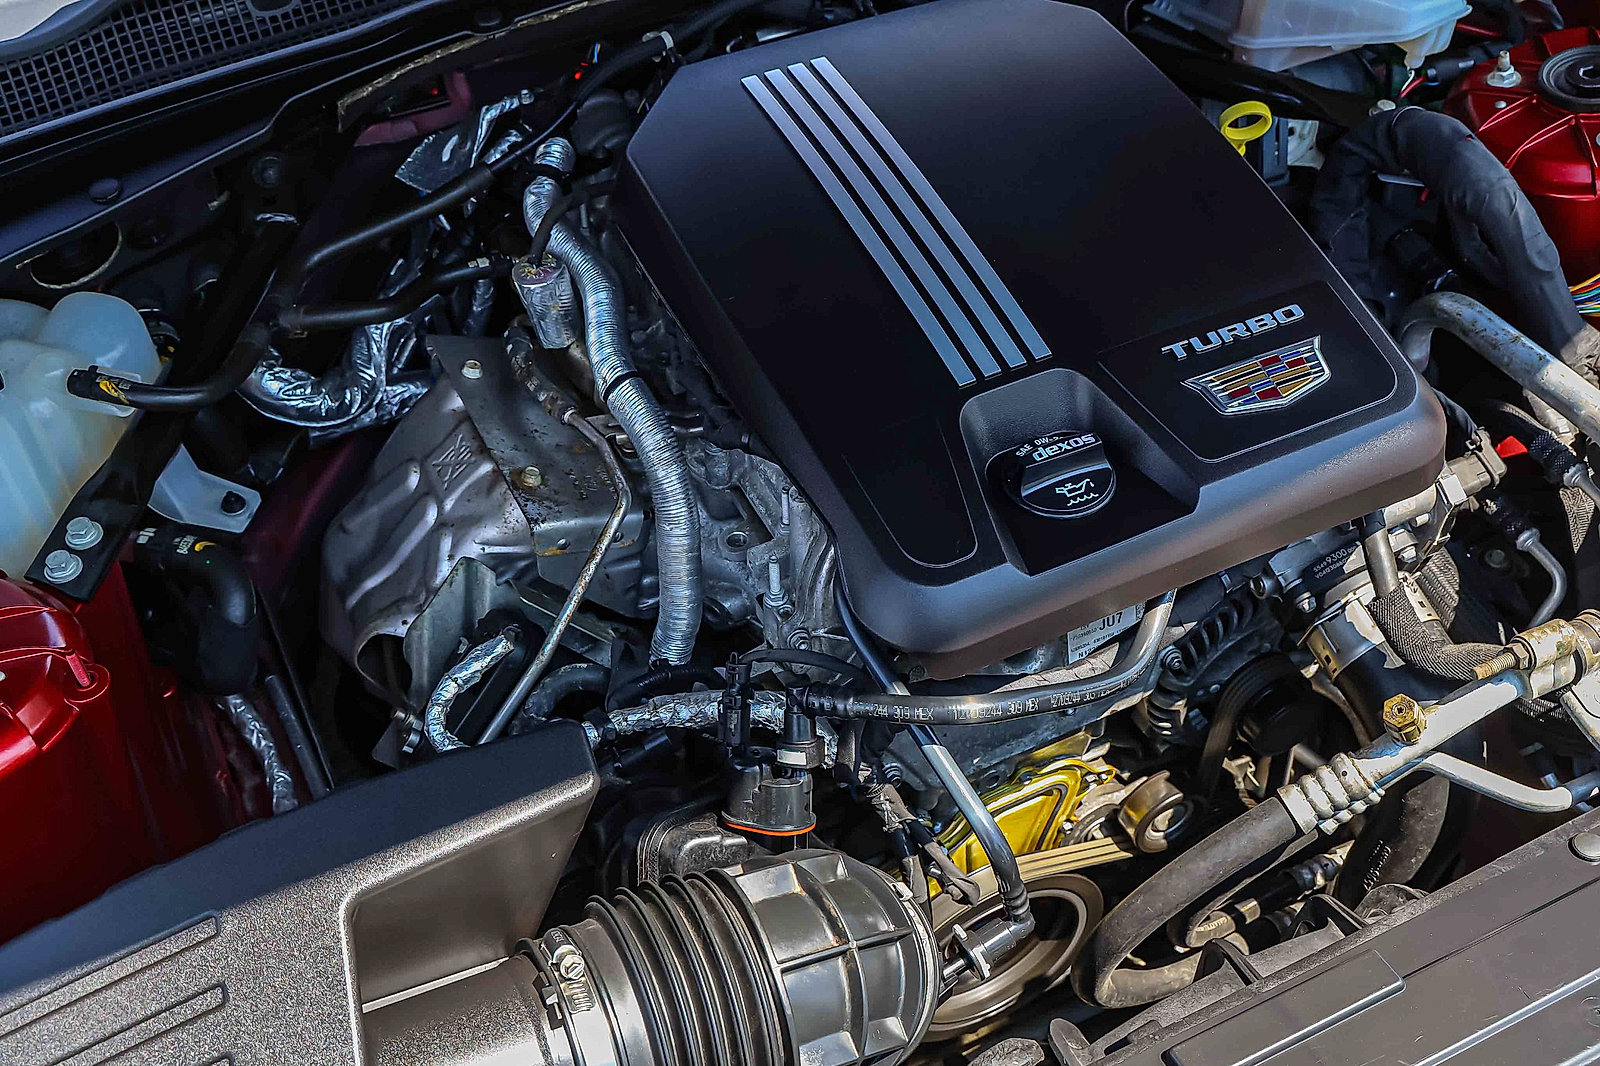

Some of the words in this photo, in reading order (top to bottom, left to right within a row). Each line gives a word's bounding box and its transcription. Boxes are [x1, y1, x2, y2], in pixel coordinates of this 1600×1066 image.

[1161, 304, 1305, 361] TURBO
[1015, 443, 1033, 457] SAE
[1032, 433, 1096, 461] dexos
[1099, 611, 1123, 631] JU7
[914, 706, 934, 721] MEX
